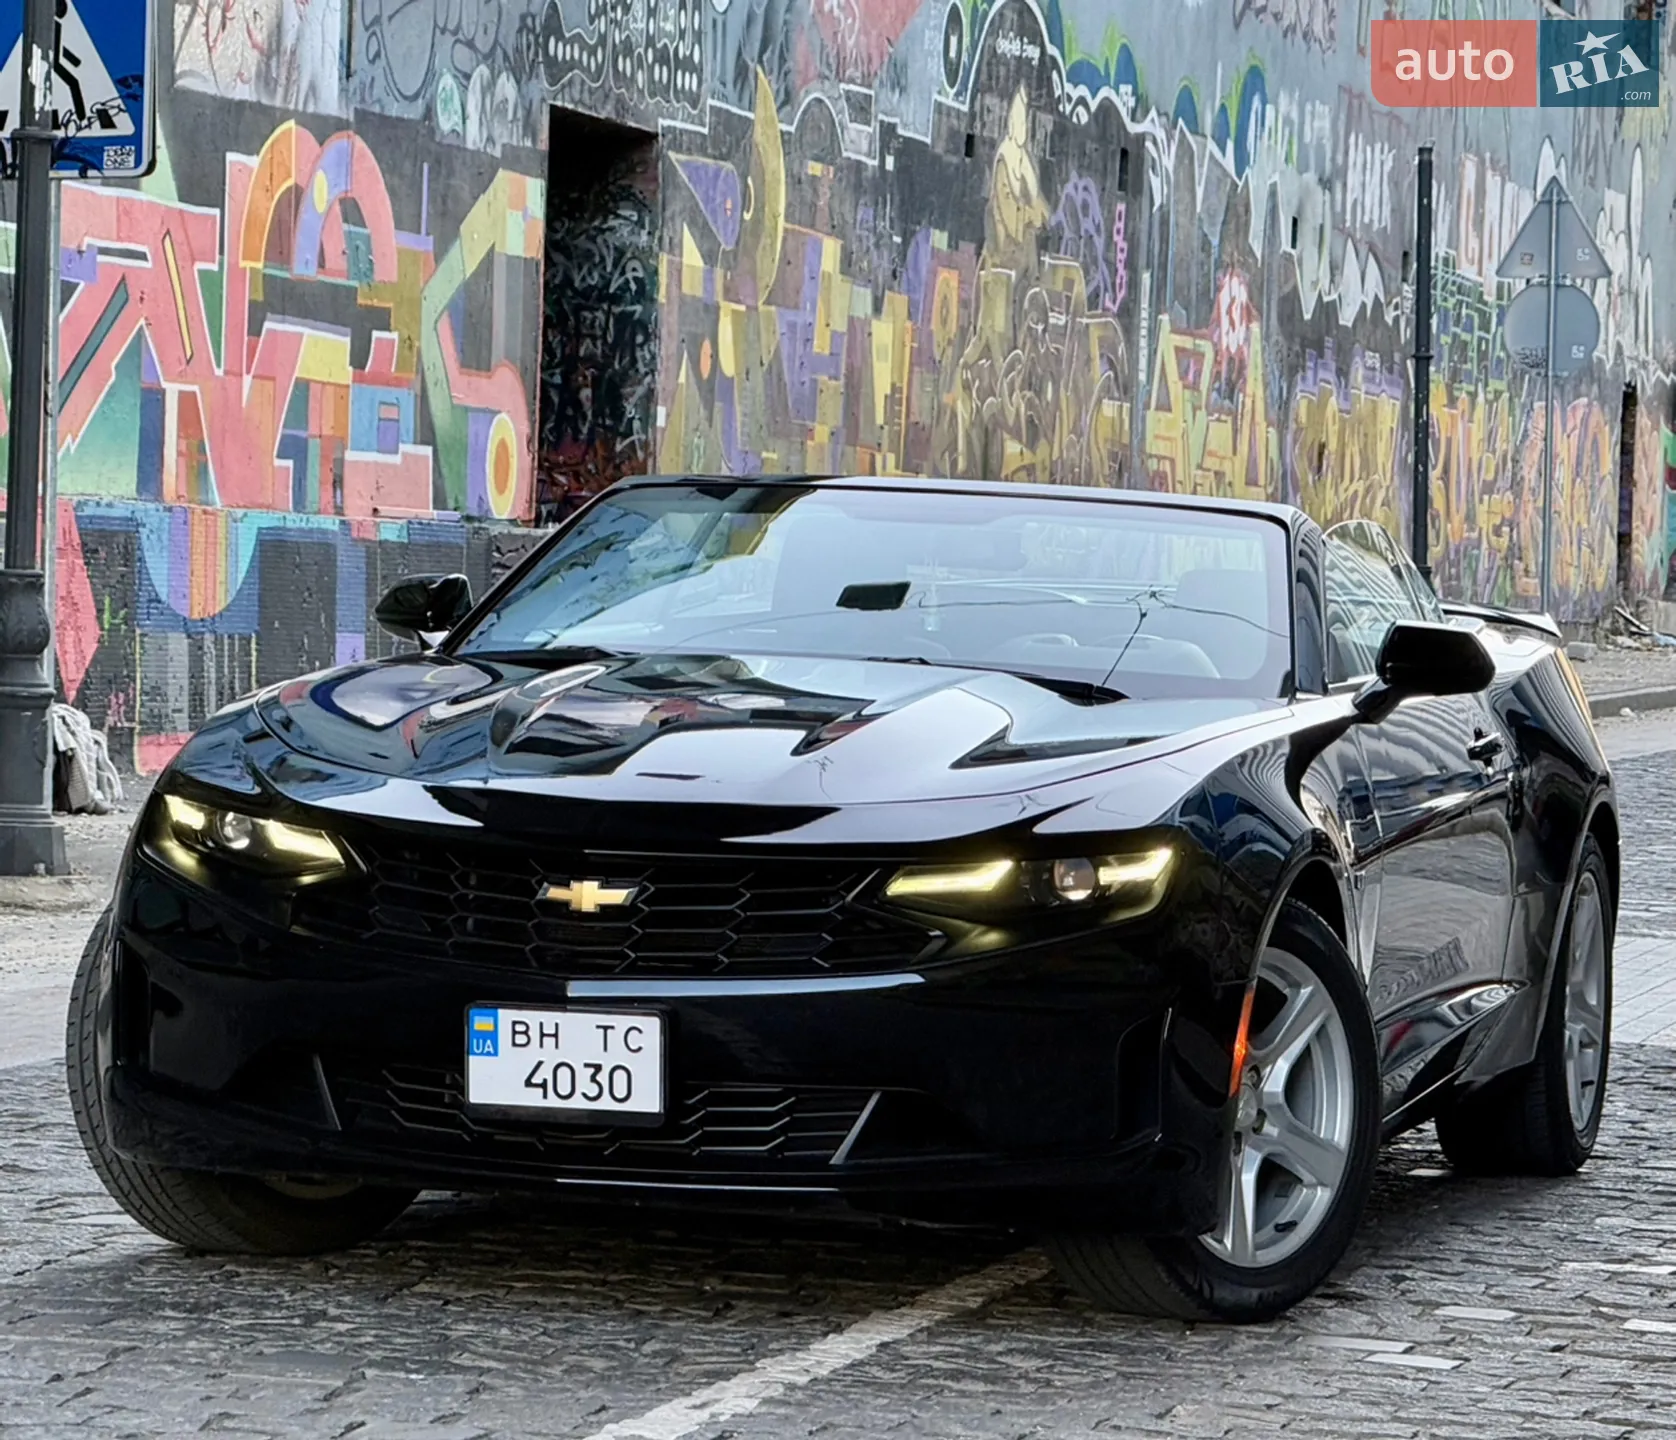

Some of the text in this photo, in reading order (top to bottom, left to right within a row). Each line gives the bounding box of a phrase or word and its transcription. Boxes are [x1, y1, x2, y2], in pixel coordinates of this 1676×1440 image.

[473, 1038, 494, 1054] UA
[511, 1020, 644, 1053] BH TC
[524, 1060, 633, 1104] 4030
